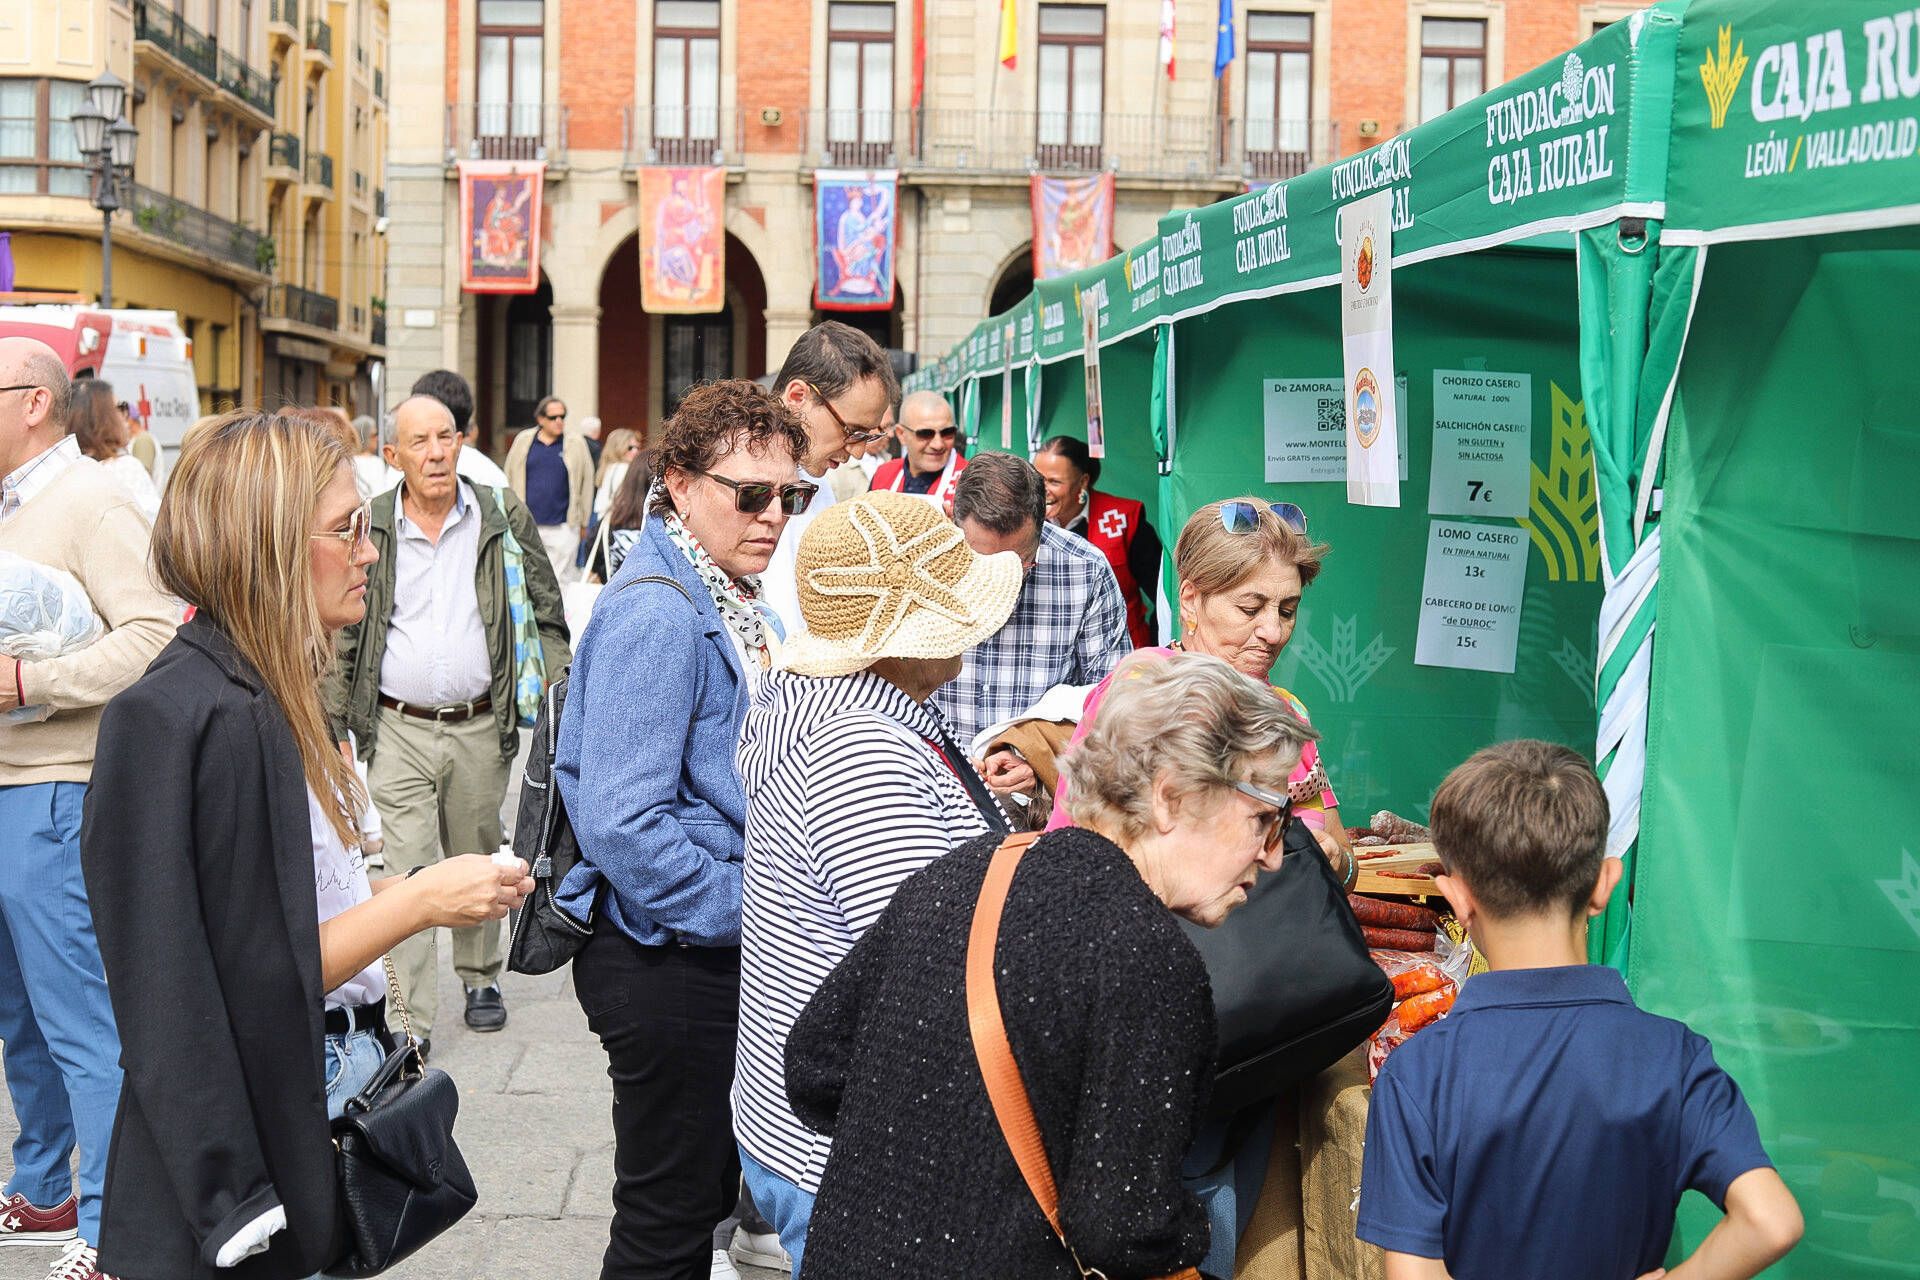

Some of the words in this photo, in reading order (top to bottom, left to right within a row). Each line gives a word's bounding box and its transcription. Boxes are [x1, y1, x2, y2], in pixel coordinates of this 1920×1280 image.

[1751, 29, 1852, 123] CAJA
[1745, 130, 1788, 178] LEÓN
[1806, 117, 1918, 170] VALLADOLID
[1488, 147, 1534, 206] CAJA
[1538, 124, 1613, 193] RURAL
[1235, 235, 1257, 274] CAJA
[1258, 224, 1291, 267] RURAL
[1180, 254, 1204, 291] RURAL
[1274, 383, 1287, 393] De
[1442, 376, 1483, 386] CHORIZO
[1485, 378, 1521, 388] CASERO
[1453, 393, 1486, 401] NATURAL
[1435, 419, 1491, 432] SALCHICHÓN
[1493, 423, 1527, 433] CASERO
[1458, 438, 1469, 446] SIN
[1471, 438, 1499, 447] GLUTEN
[1322, 455, 1347, 463] compra
[1458, 451, 1470, 460] SIN
[1472, 452, 1503, 460] LACTOSA
[1438, 527, 1471, 540] LOMO
[1476, 531, 1519, 544] CASERO
[1442, 547, 1453, 555] EN
[1454, 548, 1475, 557] TRIPA
[1476, 550, 1511, 561] NATURAL
[1465, 565, 1486, 578] 13€
[1425, 597, 1473, 610] CABECERO
[1474, 601, 1487, 611] DE
[1488, 603, 1517, 614] LOMO
[1456, 636, 1478, 648] 15€
